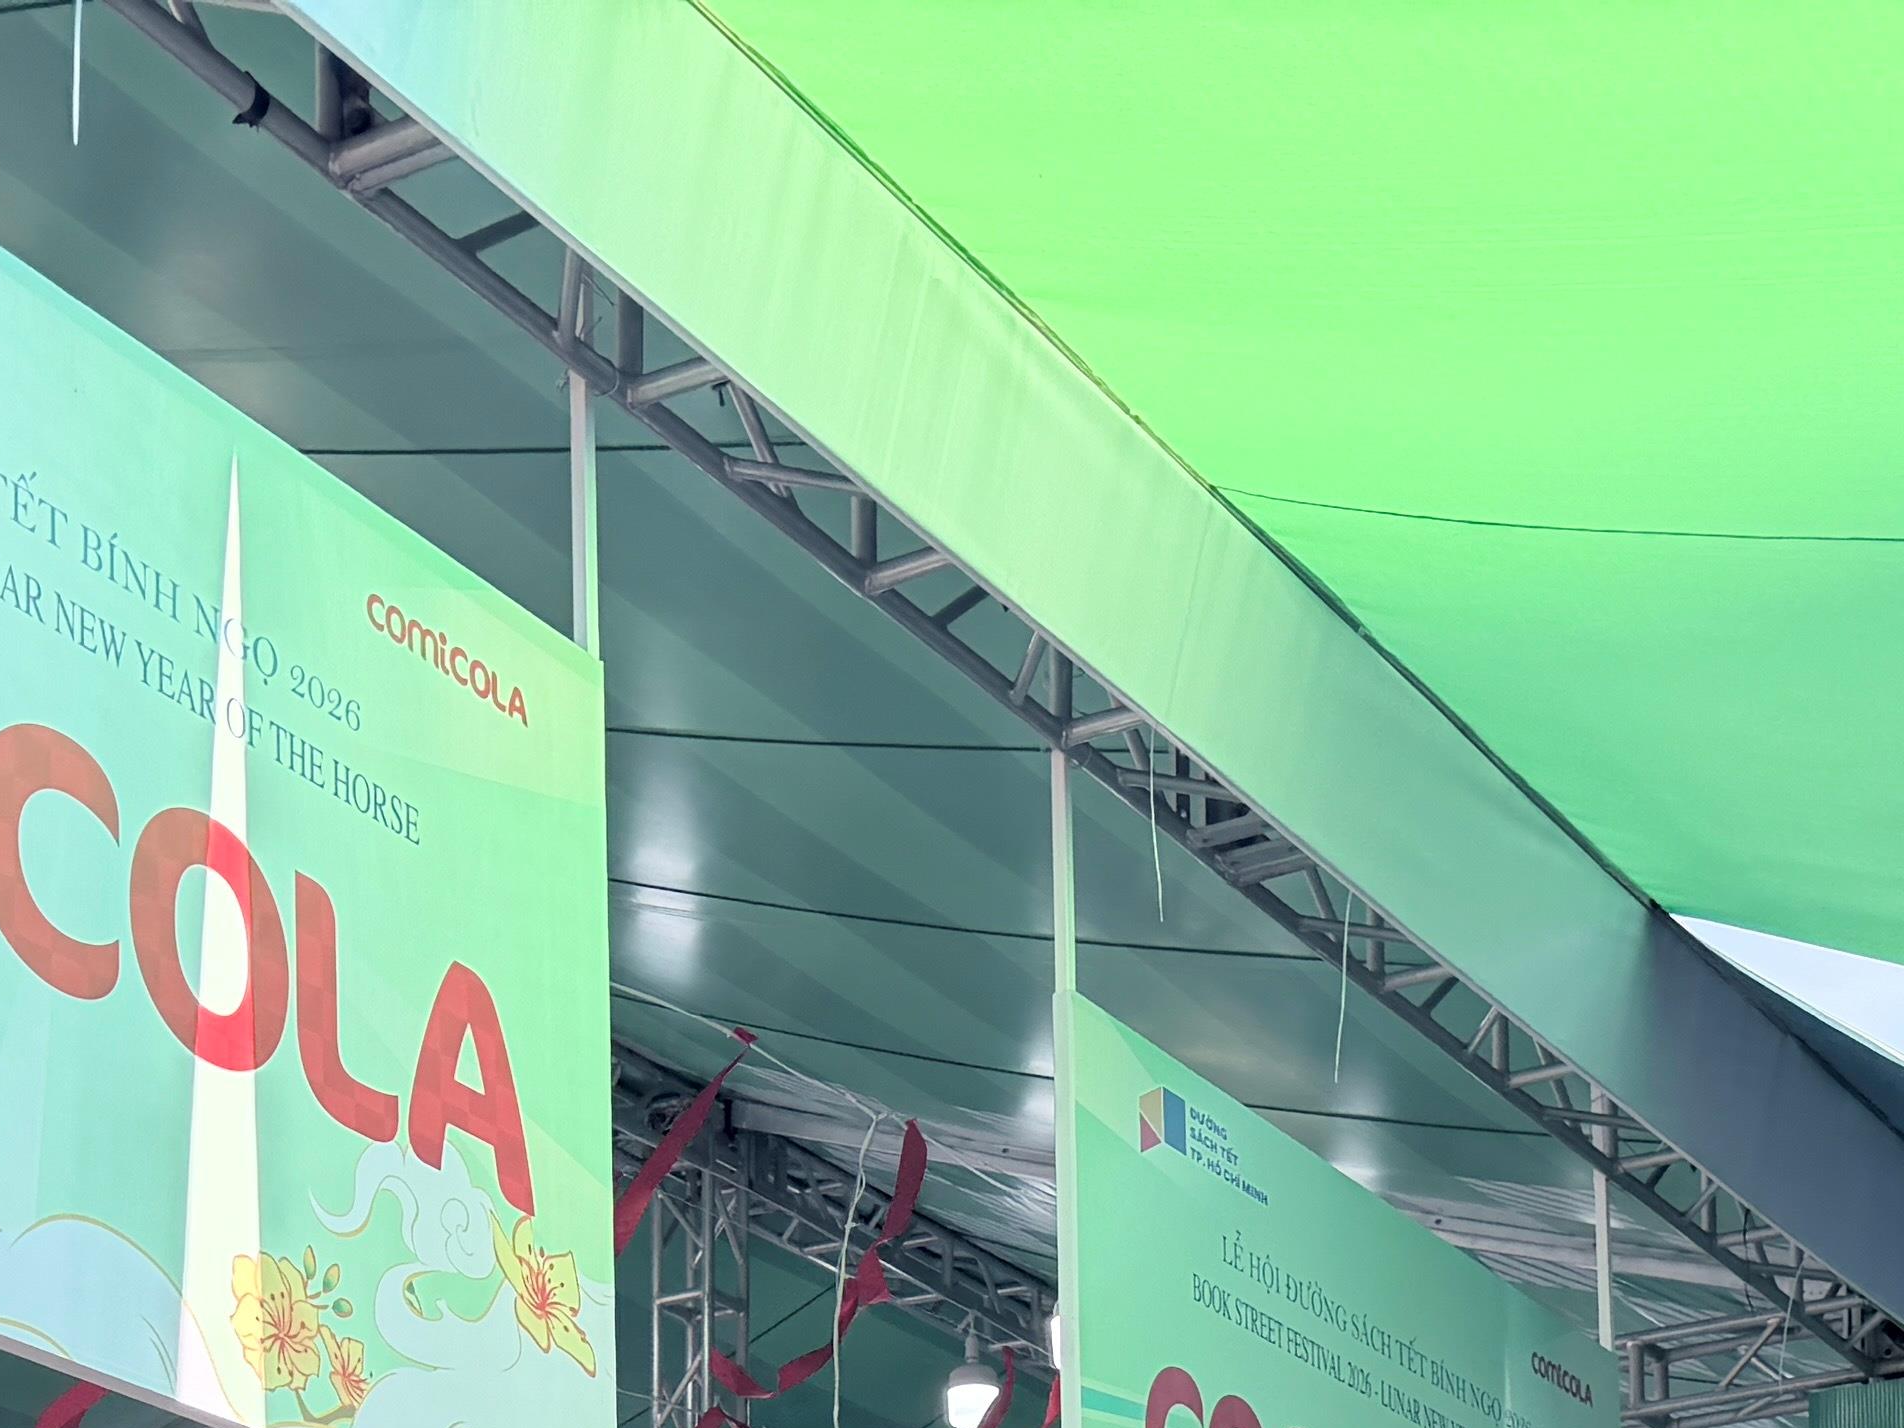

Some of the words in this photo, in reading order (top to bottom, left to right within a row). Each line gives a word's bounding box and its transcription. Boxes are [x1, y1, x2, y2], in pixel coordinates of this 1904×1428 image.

[79, 524, 182, 624] BÍNH
[193, 592, 280, 687] NGỌ
[290, 664, 362, 732] 2026
[54, 591, 127, 669] NEW
[134, 640, 217, 726] YEAR
[226, 696, 264, 749] OF
[269, 719, 327, 790] THE
[332, 758, 422, 847] HORSE
[1192, 1272, 1232, 1321] BOOK
[1235, 1297, 1285, 1349] STREET
[1287, 1327, 1346, 1384] FESTIVAL
[1347, 1361, 1373, 1399] 2026
[1381, 1380, 1421, 1426] LUNAR
[1285, 1273, 1348, 1333] ĐƯỜNG
[1351, 1313, 1392, 1360] SÁCH
[1395, 1336, 1429, 1379] TẾT
[1470, 1382, 1502, 1427] NGỌ
